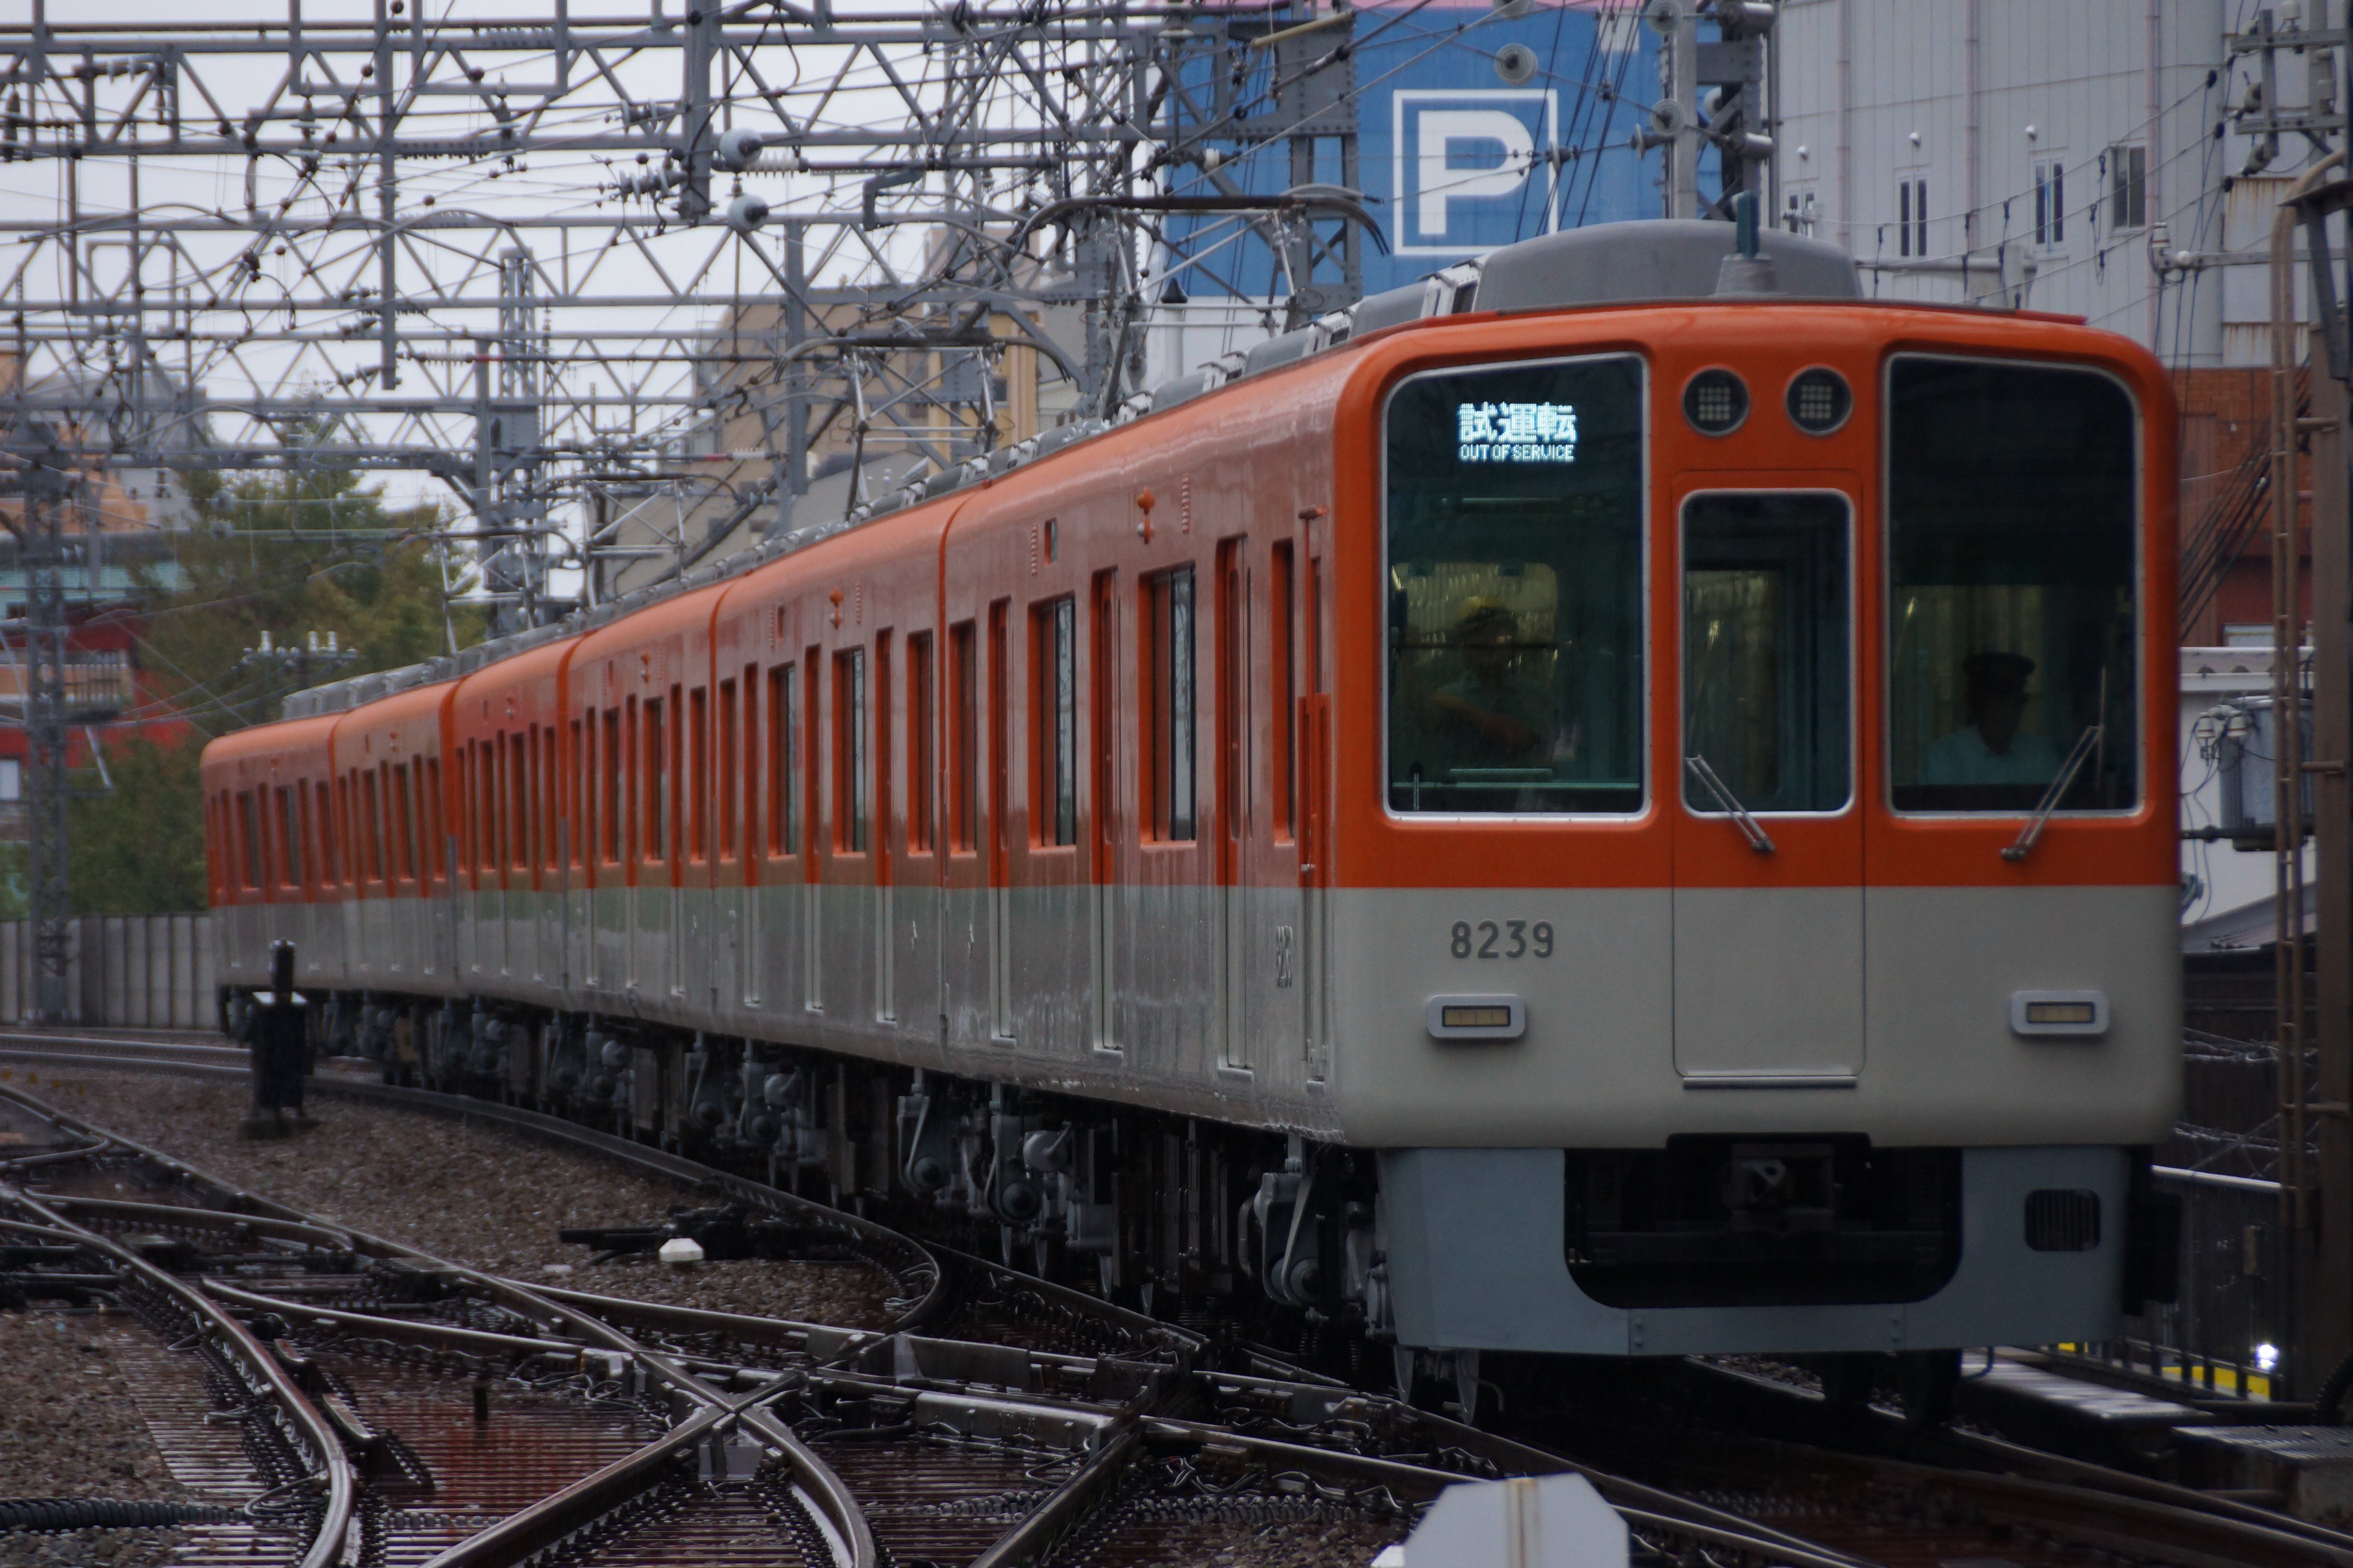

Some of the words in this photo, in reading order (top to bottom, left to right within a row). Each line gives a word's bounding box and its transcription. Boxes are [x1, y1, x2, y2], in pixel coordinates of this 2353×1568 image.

[1419, 110, 1534, 235] P
[1457, 401, 1576, 443] 試運転
[1459, 444, 1490, 462] OUT
[1491, 444, 1510, 462] OF
[1512, 444, 1575, 462] SERVICE
[1451, 919, 1553, 959] 8239
